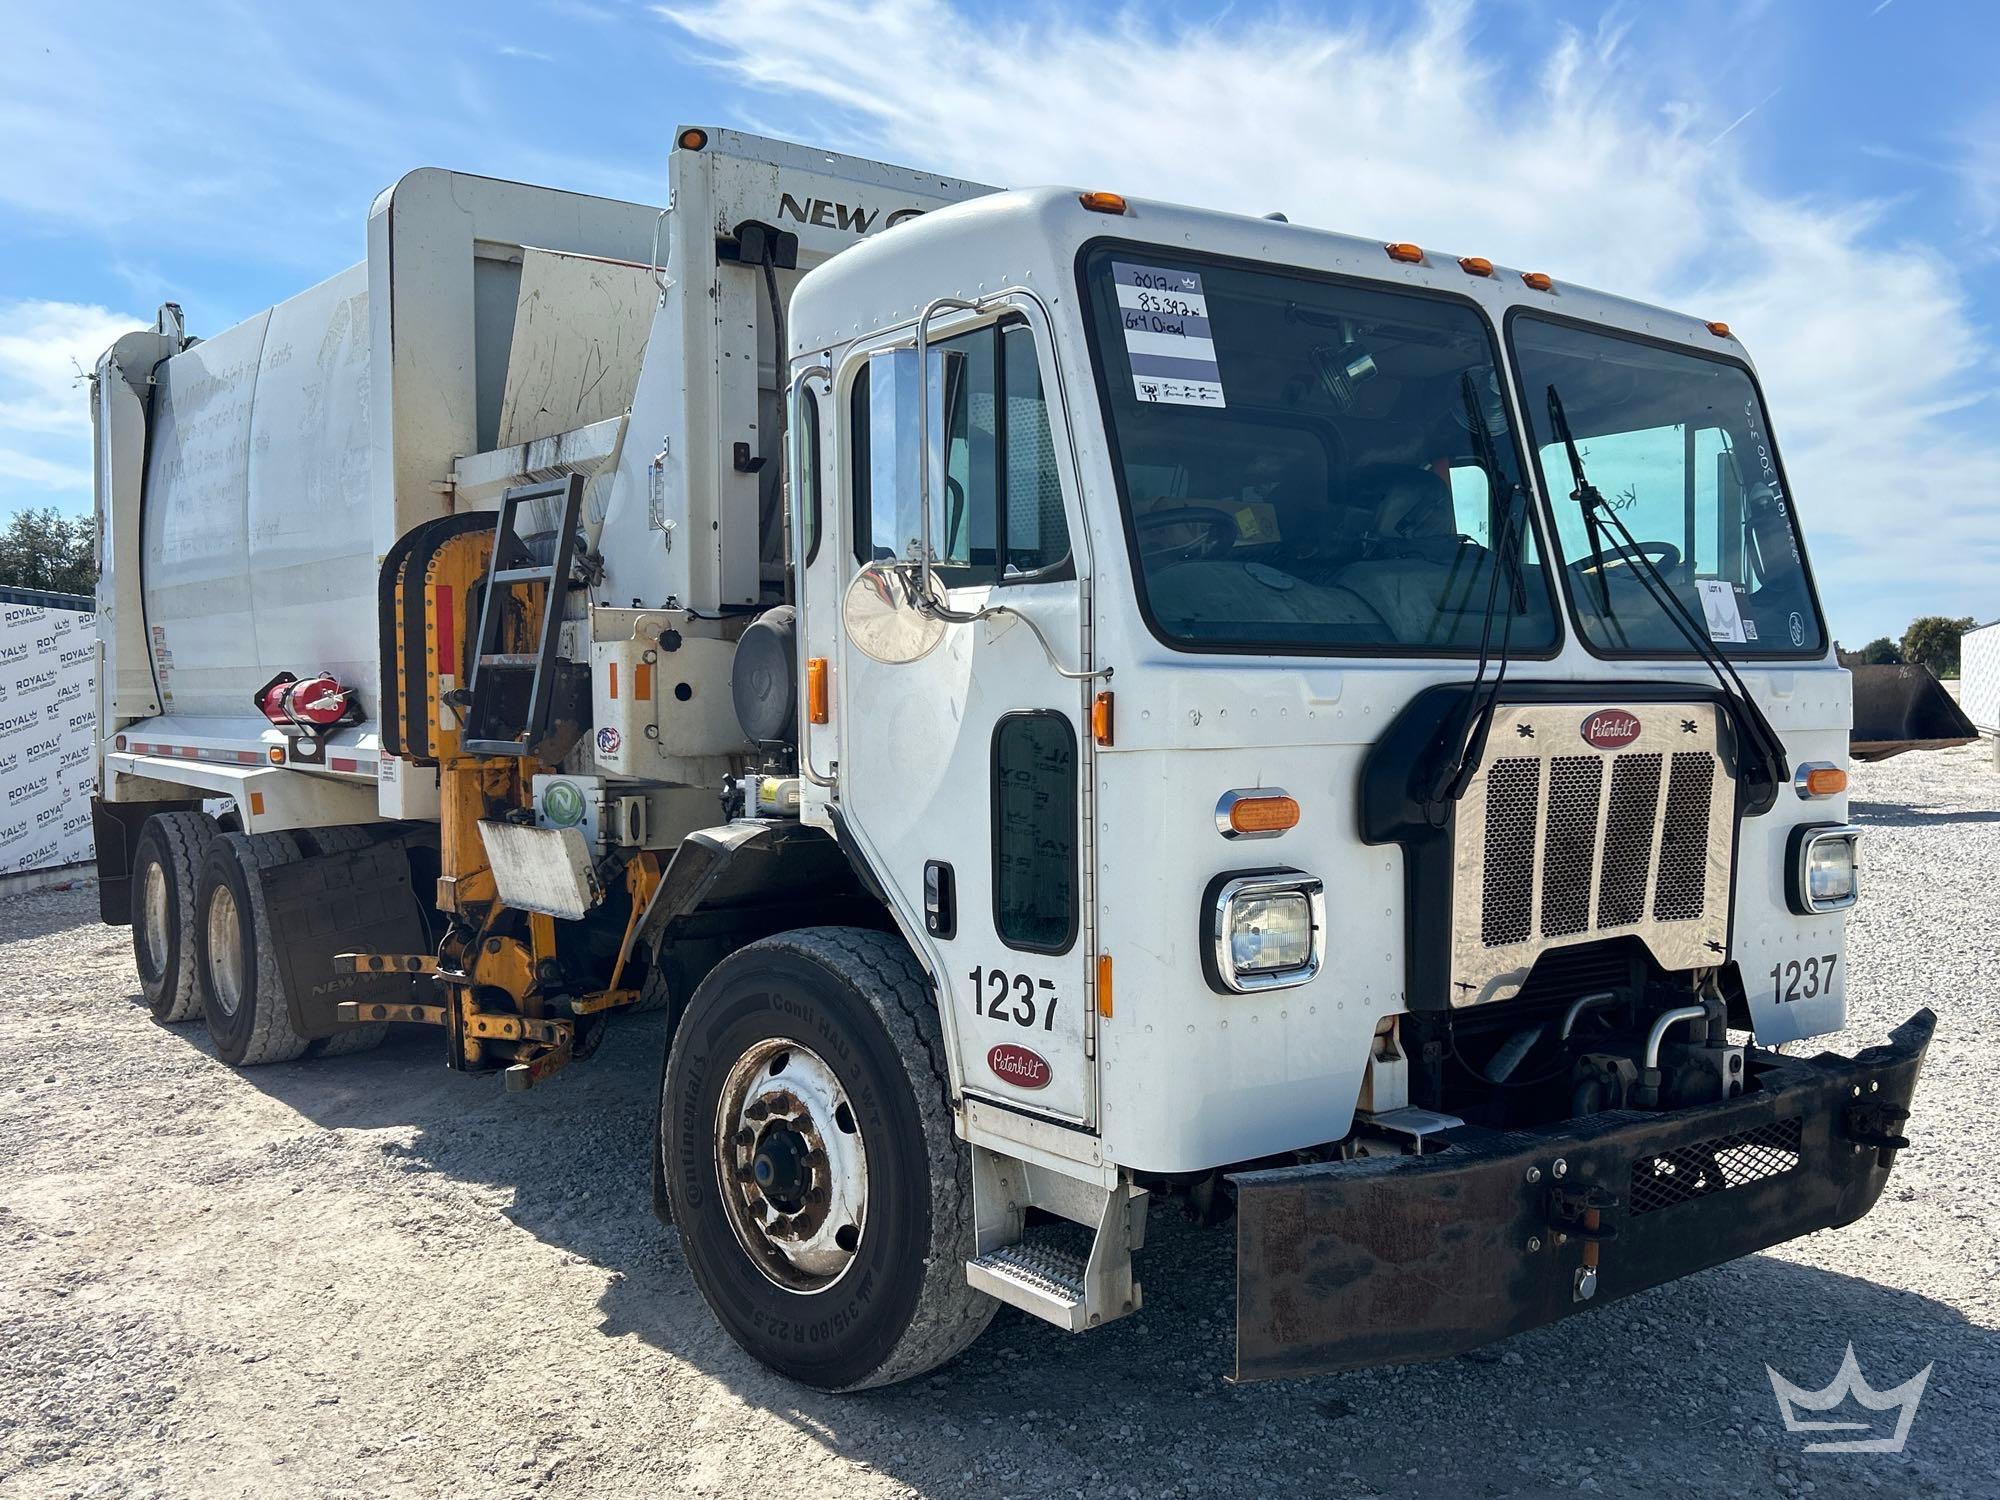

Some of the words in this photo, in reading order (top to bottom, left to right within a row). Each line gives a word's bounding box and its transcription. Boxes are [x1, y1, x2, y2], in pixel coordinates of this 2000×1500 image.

[777, 192, 880, 234] NEW
[5, 607, 37, 621] ROYAL
[60, 648, 88, 662] ROYAL
[16, 673, 47, 690] ROYAL
[0, 714, 30, 731] ROYAL
[1590, 717, 1638, 740] Peterbilt
[26, 738, 57, 757] ROYAL
[8, 781, 40, 800] ROYAL
[63, 812, 91, 831] ROYAL
[19, 846, 50, 867] ROYAL
[312, 975, 359, 996] NEW
[1769, 953, 1837, 1005] 1237
[773, 993, 815, 1024] Conti
[969, 965, 1058, 1031] 1237
[993, 1048, 1044, 1079] Peterbilt
